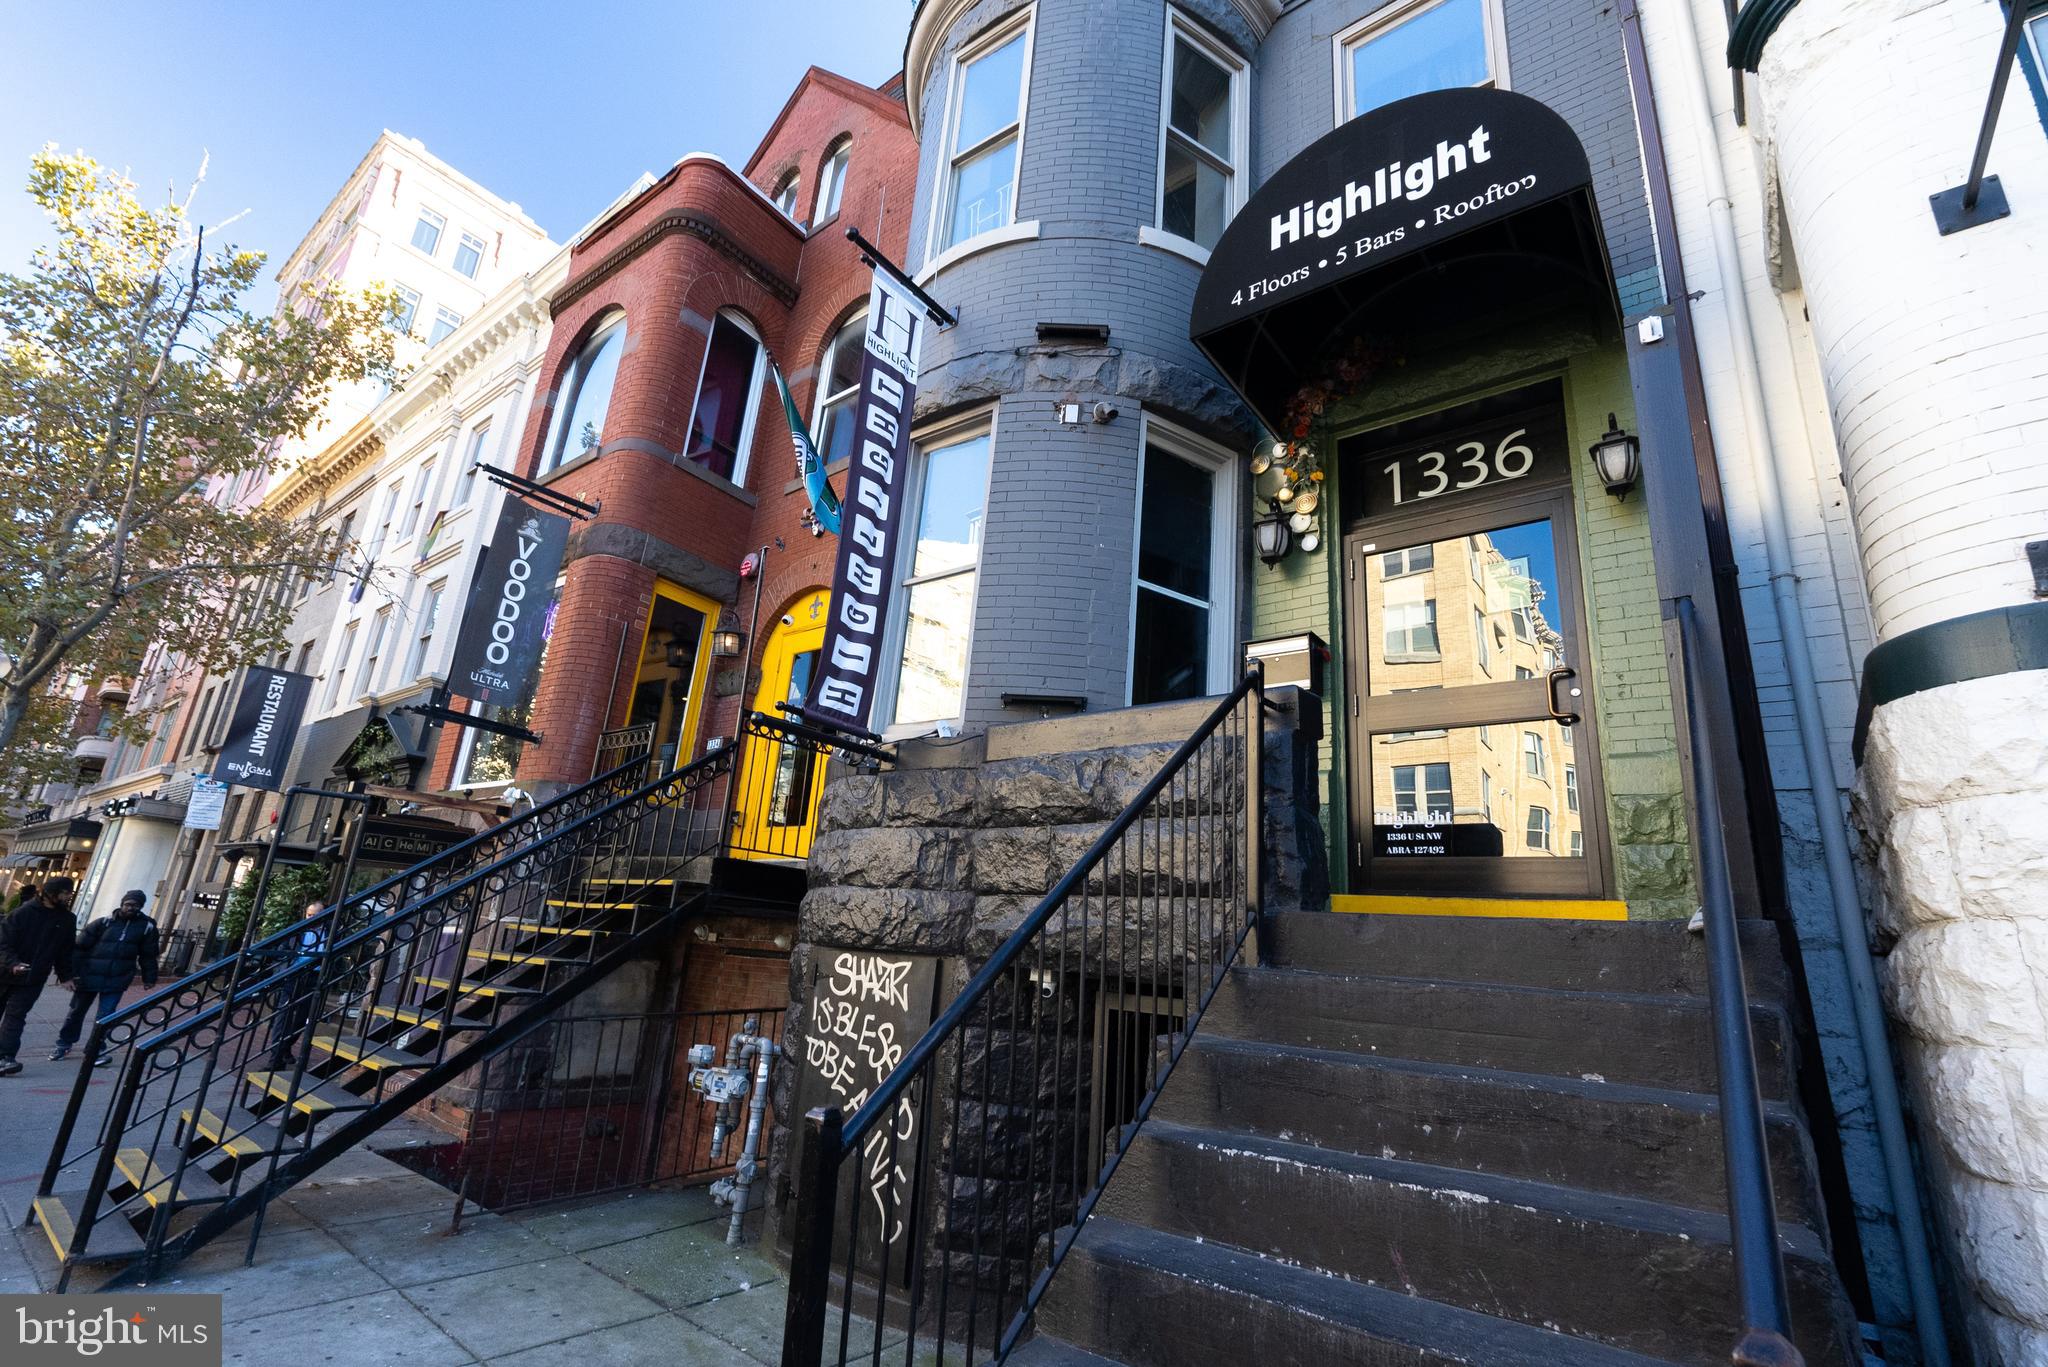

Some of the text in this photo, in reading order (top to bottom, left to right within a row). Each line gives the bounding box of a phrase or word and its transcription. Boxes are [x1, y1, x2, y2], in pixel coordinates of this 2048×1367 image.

[1270, 124, 1491, 251] Highlight
[1231, 289, 1243, 306] 4
[1248, 264, 1310, 301] Floors
[1335, 246, 1347, 265] 5
[1354, 227, 1405, 258] Bars
[867, 335, 916, 379] HIGHLIGHT
[869, 282, 921, 366] H
[1384, 428, 1534, 504] 1336
[824, 374, 904, 710] HIGHLIGHT
[486, 536, 538, 665] VOODOO
[248, 674, 288, 757] RESTAURANT
[470, 671, 510, 690] ULTRA
[1374, 810, 1453, 828] Highlight
[1386, 846, 1445, 854] ABRA-127492
[1387, 832, 1442, 841] 1336 U St NW
